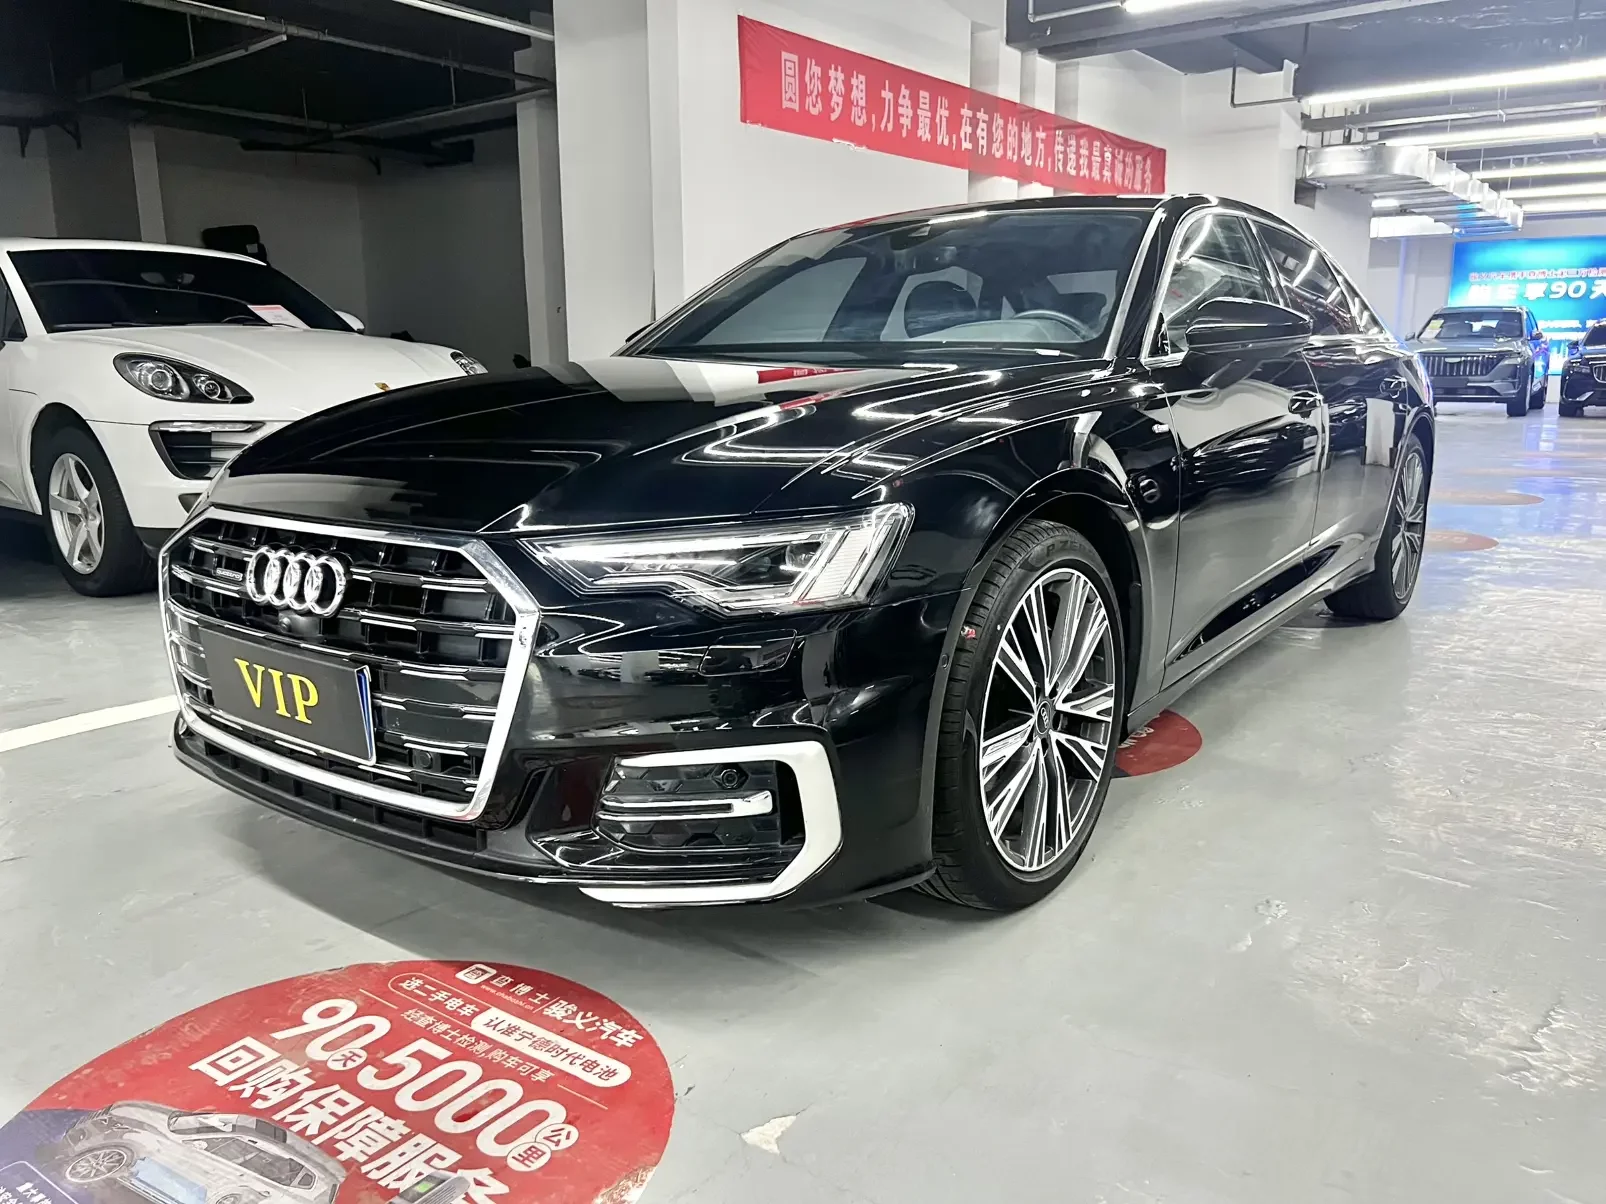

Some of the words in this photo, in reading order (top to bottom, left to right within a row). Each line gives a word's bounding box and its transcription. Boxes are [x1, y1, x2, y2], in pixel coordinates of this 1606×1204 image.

[234, 657, 319, 724] VIP
[398, 977, 481, 1017] 选二手电车
[483, 1017, 619, 1081] 认准宁德时代电池
[400, 1008, 555, 1083] 经查博士检测,购车可享
[542, 1000, 644, 1048] 骏义汽车
